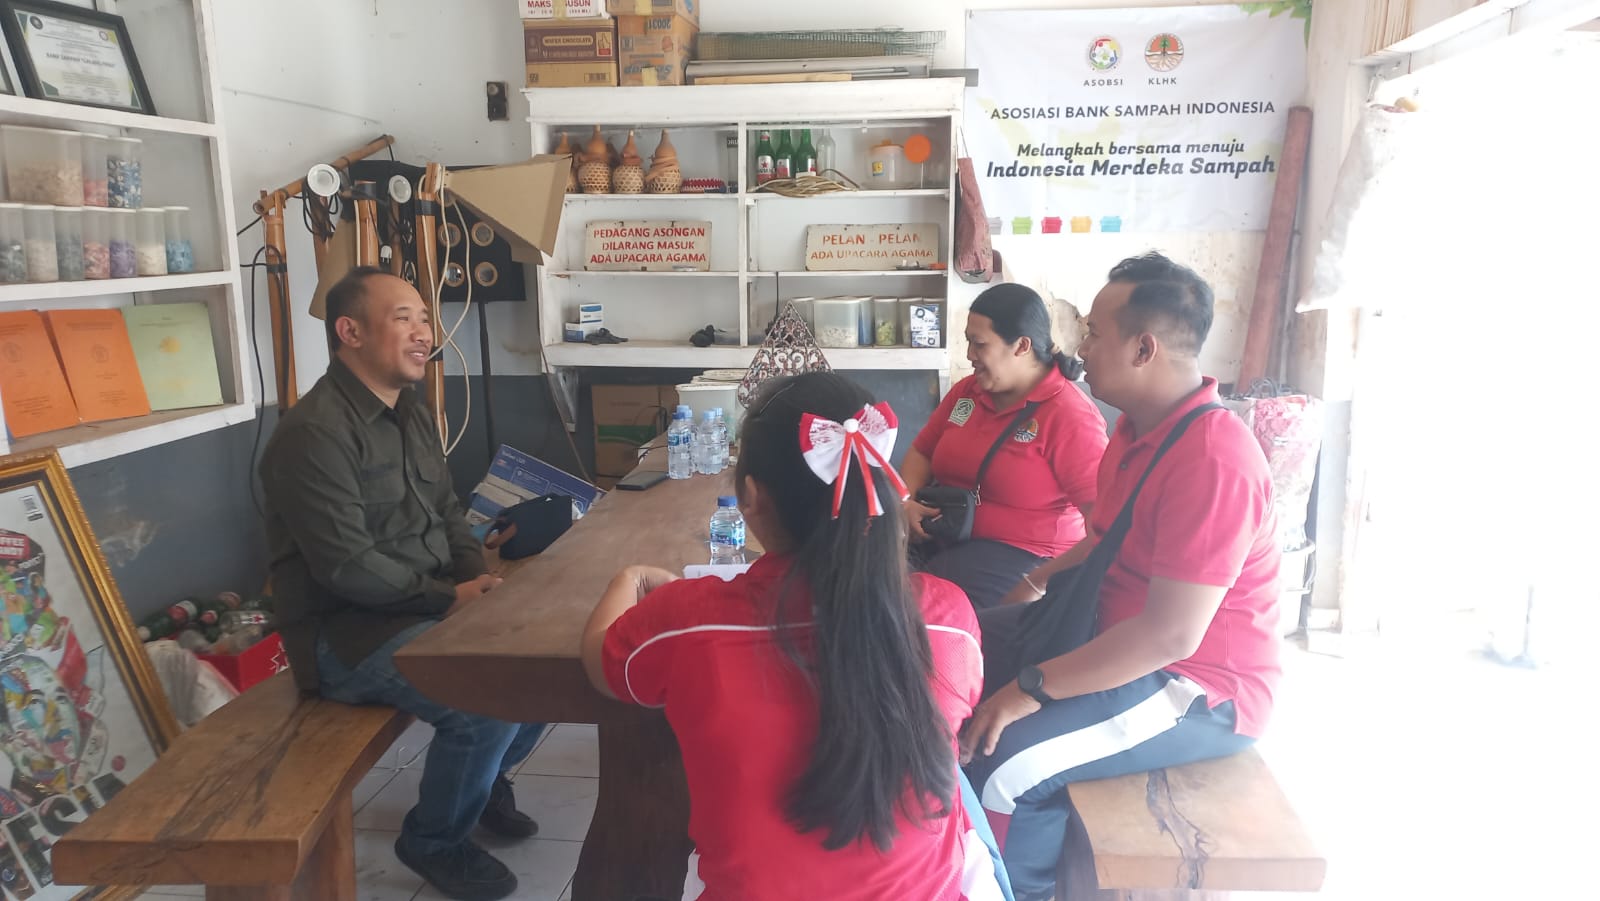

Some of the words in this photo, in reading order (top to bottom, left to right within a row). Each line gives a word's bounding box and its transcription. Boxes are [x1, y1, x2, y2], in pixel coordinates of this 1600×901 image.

[1083, 79, 1123, 87] ASOBSI
[1148, 77, 1177, 85] KLHK
[990, 106, 1060, 119] ASOSIASI
[1065, 105, 1110, 118] BANK
[1114, 103, 1181, 117] SAMPAH
[1186, 101, 1275, 114] INDONESIA
[1016, 143, 1104, 160] Melangkah
[1108, 141, 1182, 155] bersama
[1185, 139, 1245, 157] menuju
[986, 160, 1085, 178] Indonesia
[1090, 158, 1184, 176] Merdeka
[1189, 155, 1276, 179] Sampah
[593, 228, 650, 238] PEDAGANG
[653, 227, 705, 237] ASONGAN
[822, 234, 865, 245] PELAN
[602, 241, 654, 250] DILARANG
[657, 241, 695, 250] MASUK
[590, 254, 612, 263] ADA
[614, 254, 663, 263] UPACARA
[665, 253, 706, 262] AGAMA
[810, 250, 834, 260] ADA
[837, 250, 888, 259] UPACARA
[891, 249, 934, 258] AGAMA
